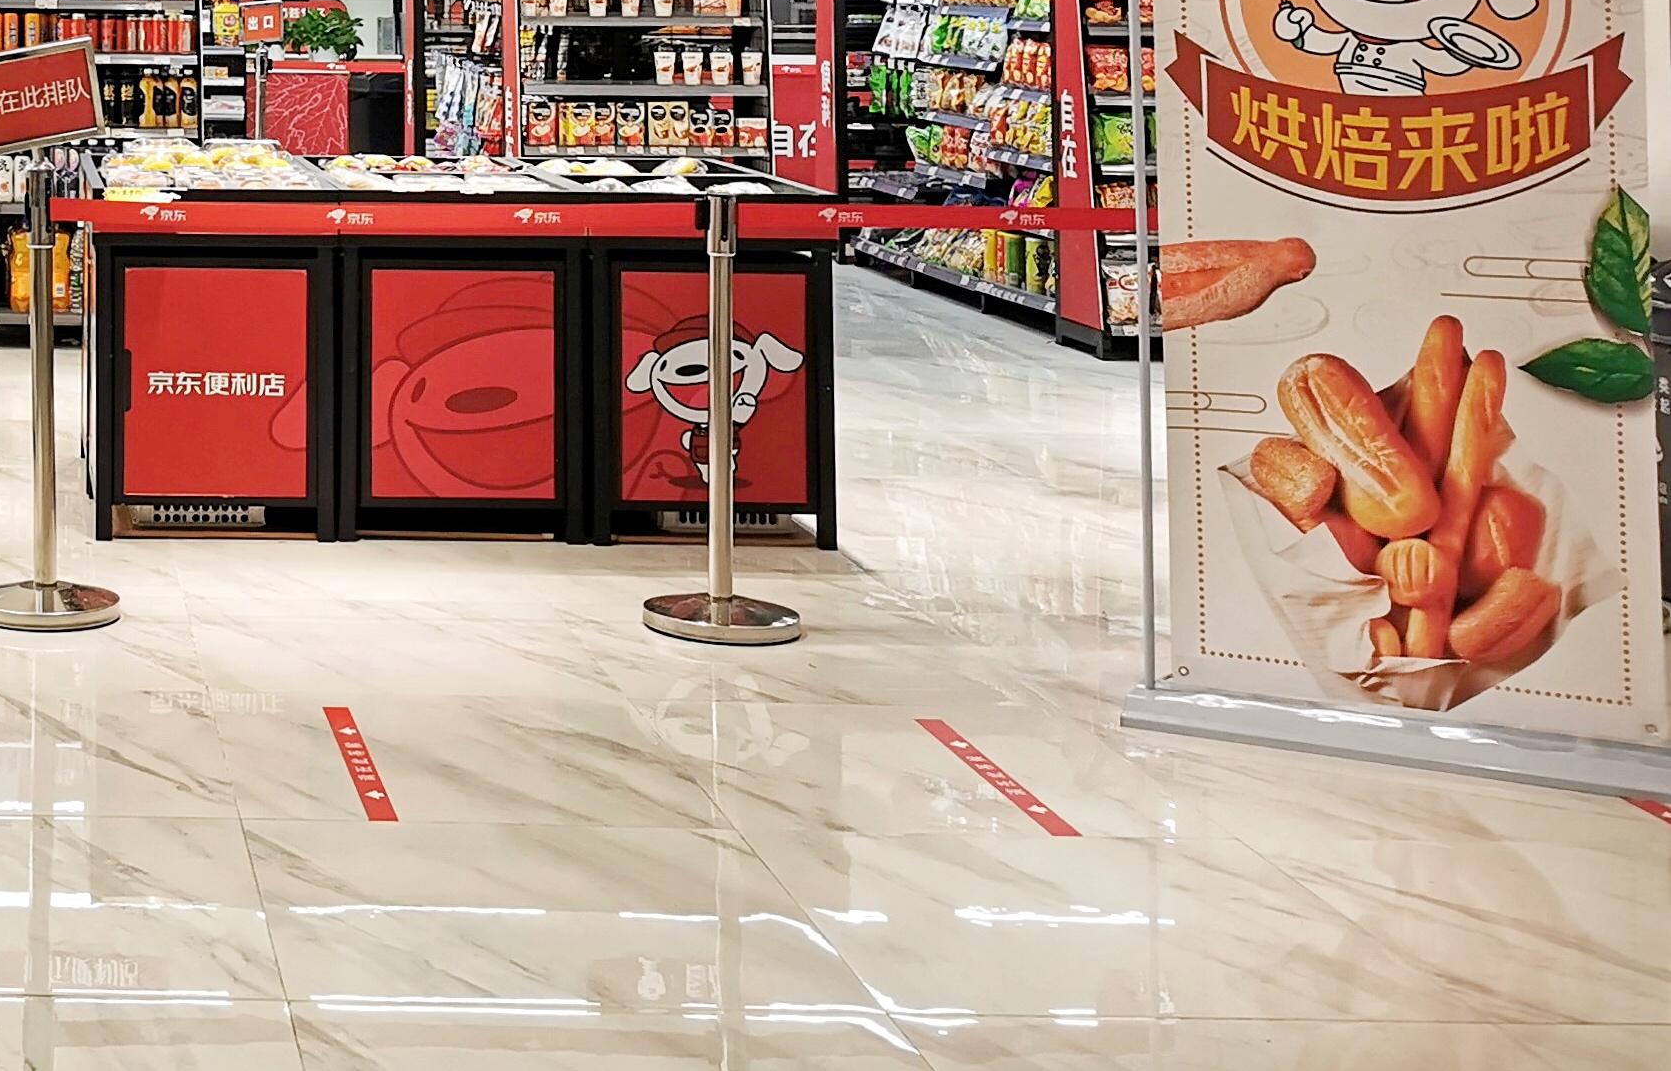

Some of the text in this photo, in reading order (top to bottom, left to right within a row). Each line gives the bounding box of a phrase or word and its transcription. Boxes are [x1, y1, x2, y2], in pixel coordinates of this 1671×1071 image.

[248, 16, 273, 30] 出口
[1061, 89, 1077, 178] 自在
[1230, 85, 1572, 192] 烘焙来啦
[161, 210, 186, 221] 京东
[348, 213, 373, 225] 京东
[535, 212, 560, 223] 京东
[838, 212, 863, 222] 京东
[1020, 214, 1045, 225] 京东
[148, 371, 284, 396] 京东便利店
